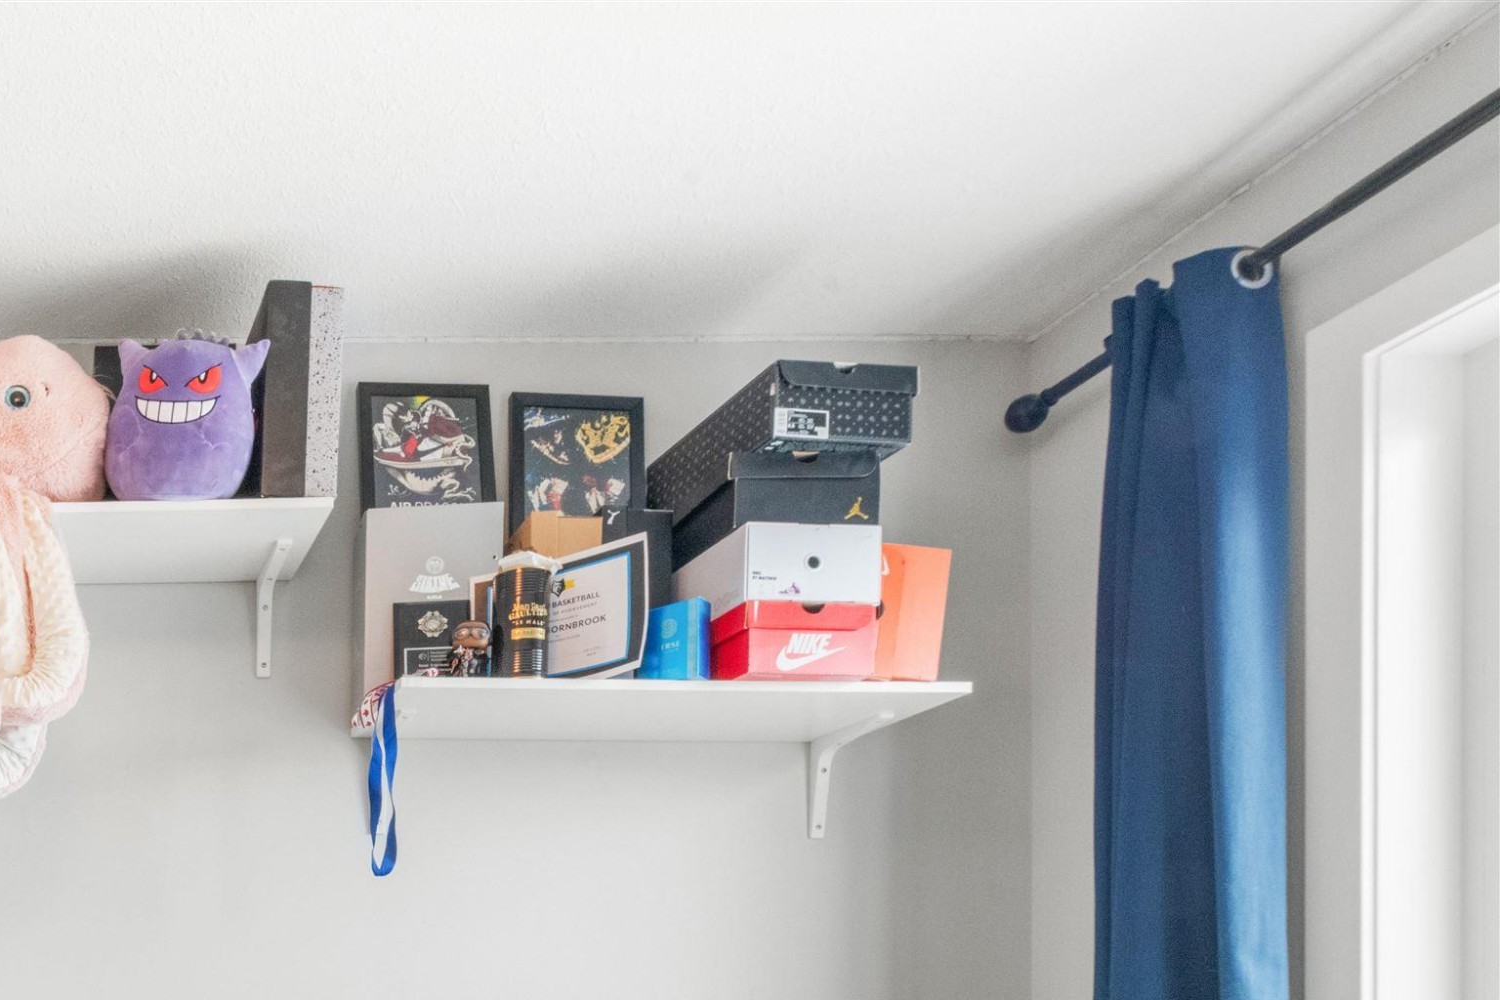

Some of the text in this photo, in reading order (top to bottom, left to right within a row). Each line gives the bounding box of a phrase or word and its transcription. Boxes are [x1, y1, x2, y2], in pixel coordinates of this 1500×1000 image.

[552, 592, 601, 608] BASKETBALL
[551, 614, 607, 633] ORNBROOK
[787, 633, 832, 655] NIKE
